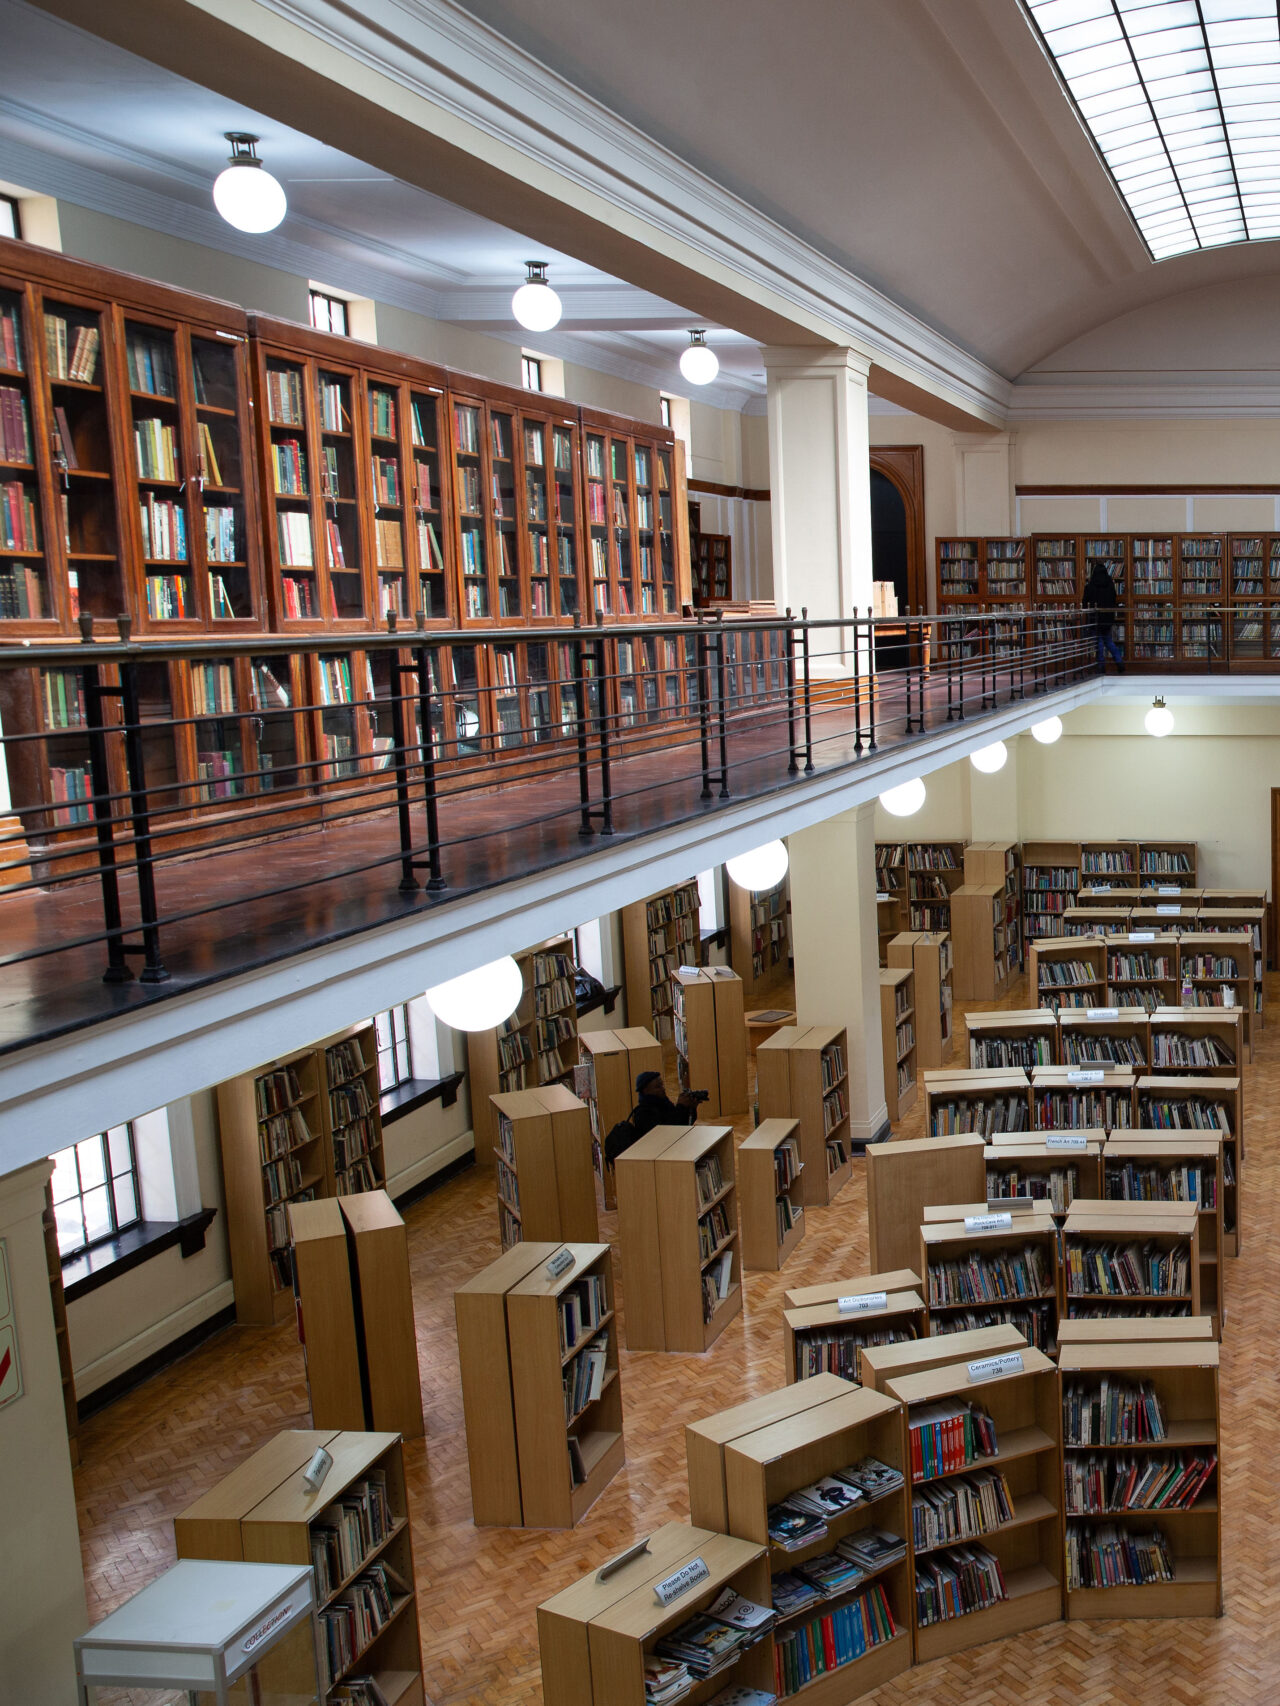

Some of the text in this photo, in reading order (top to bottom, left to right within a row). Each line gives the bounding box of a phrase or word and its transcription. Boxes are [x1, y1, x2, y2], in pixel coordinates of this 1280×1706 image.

[971, 1355, 1020, 1371] Ceramics/Pottery
[662, 1562, 700, 1591] Please Do Not
[663, 1569, 707, 1602] Re-shelve Books
